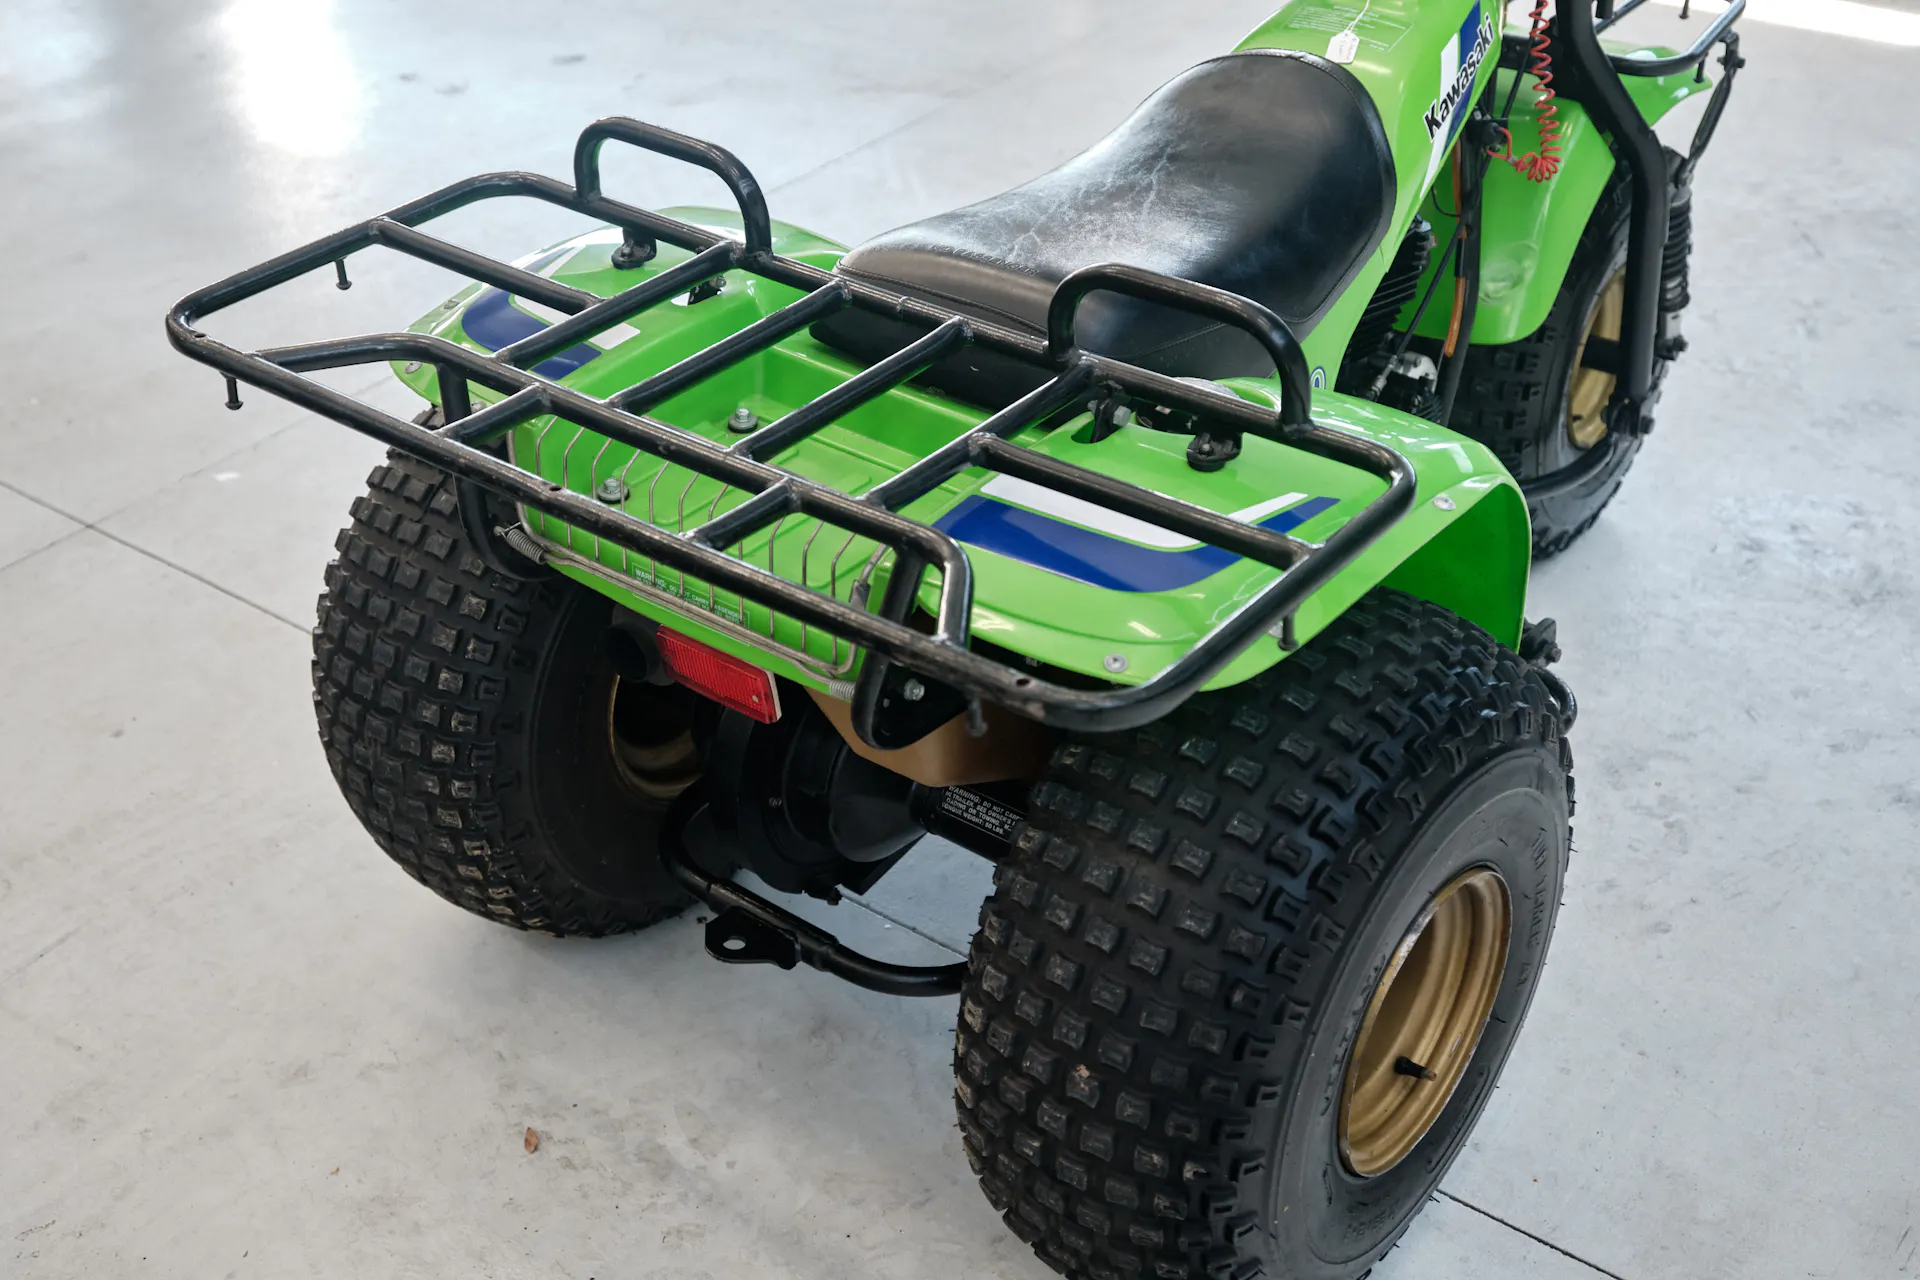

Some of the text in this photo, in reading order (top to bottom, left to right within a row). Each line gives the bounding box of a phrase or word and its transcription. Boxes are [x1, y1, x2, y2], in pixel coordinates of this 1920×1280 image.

[1423, 13, 1494, 141] Kawasaki
[946, 797, 967, 810] OADING
[968, 808, 977, 816] OR
[949, 786, 981, 803] WARNING:
[993, 805, 1005, 814] NOT
[976, 804, 987, 813] SEE
[987, 809, 1012, 825] OWNER'S
